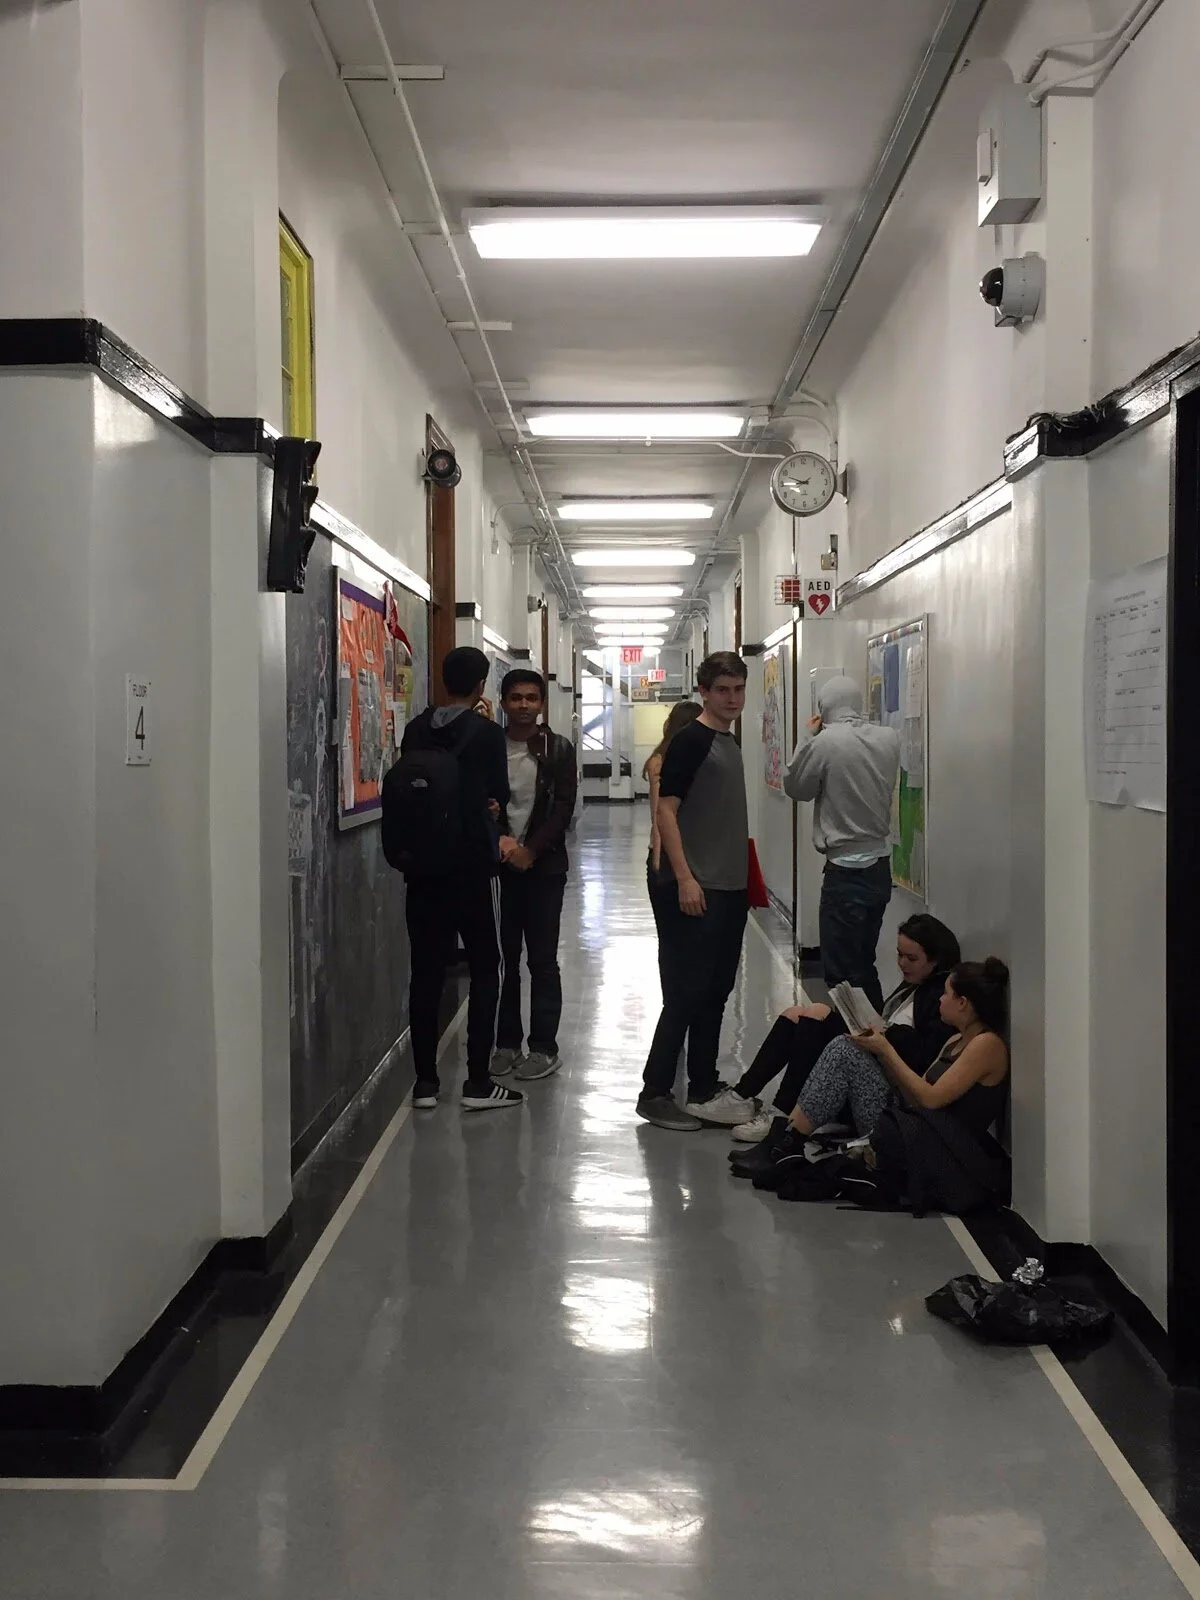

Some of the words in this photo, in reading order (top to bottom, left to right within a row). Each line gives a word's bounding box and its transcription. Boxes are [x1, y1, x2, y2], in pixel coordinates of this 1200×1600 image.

[808, 580, 831, 591] AED
[623, 648, 642, 662] EXIT
[135, 705, 146, 751] 4
